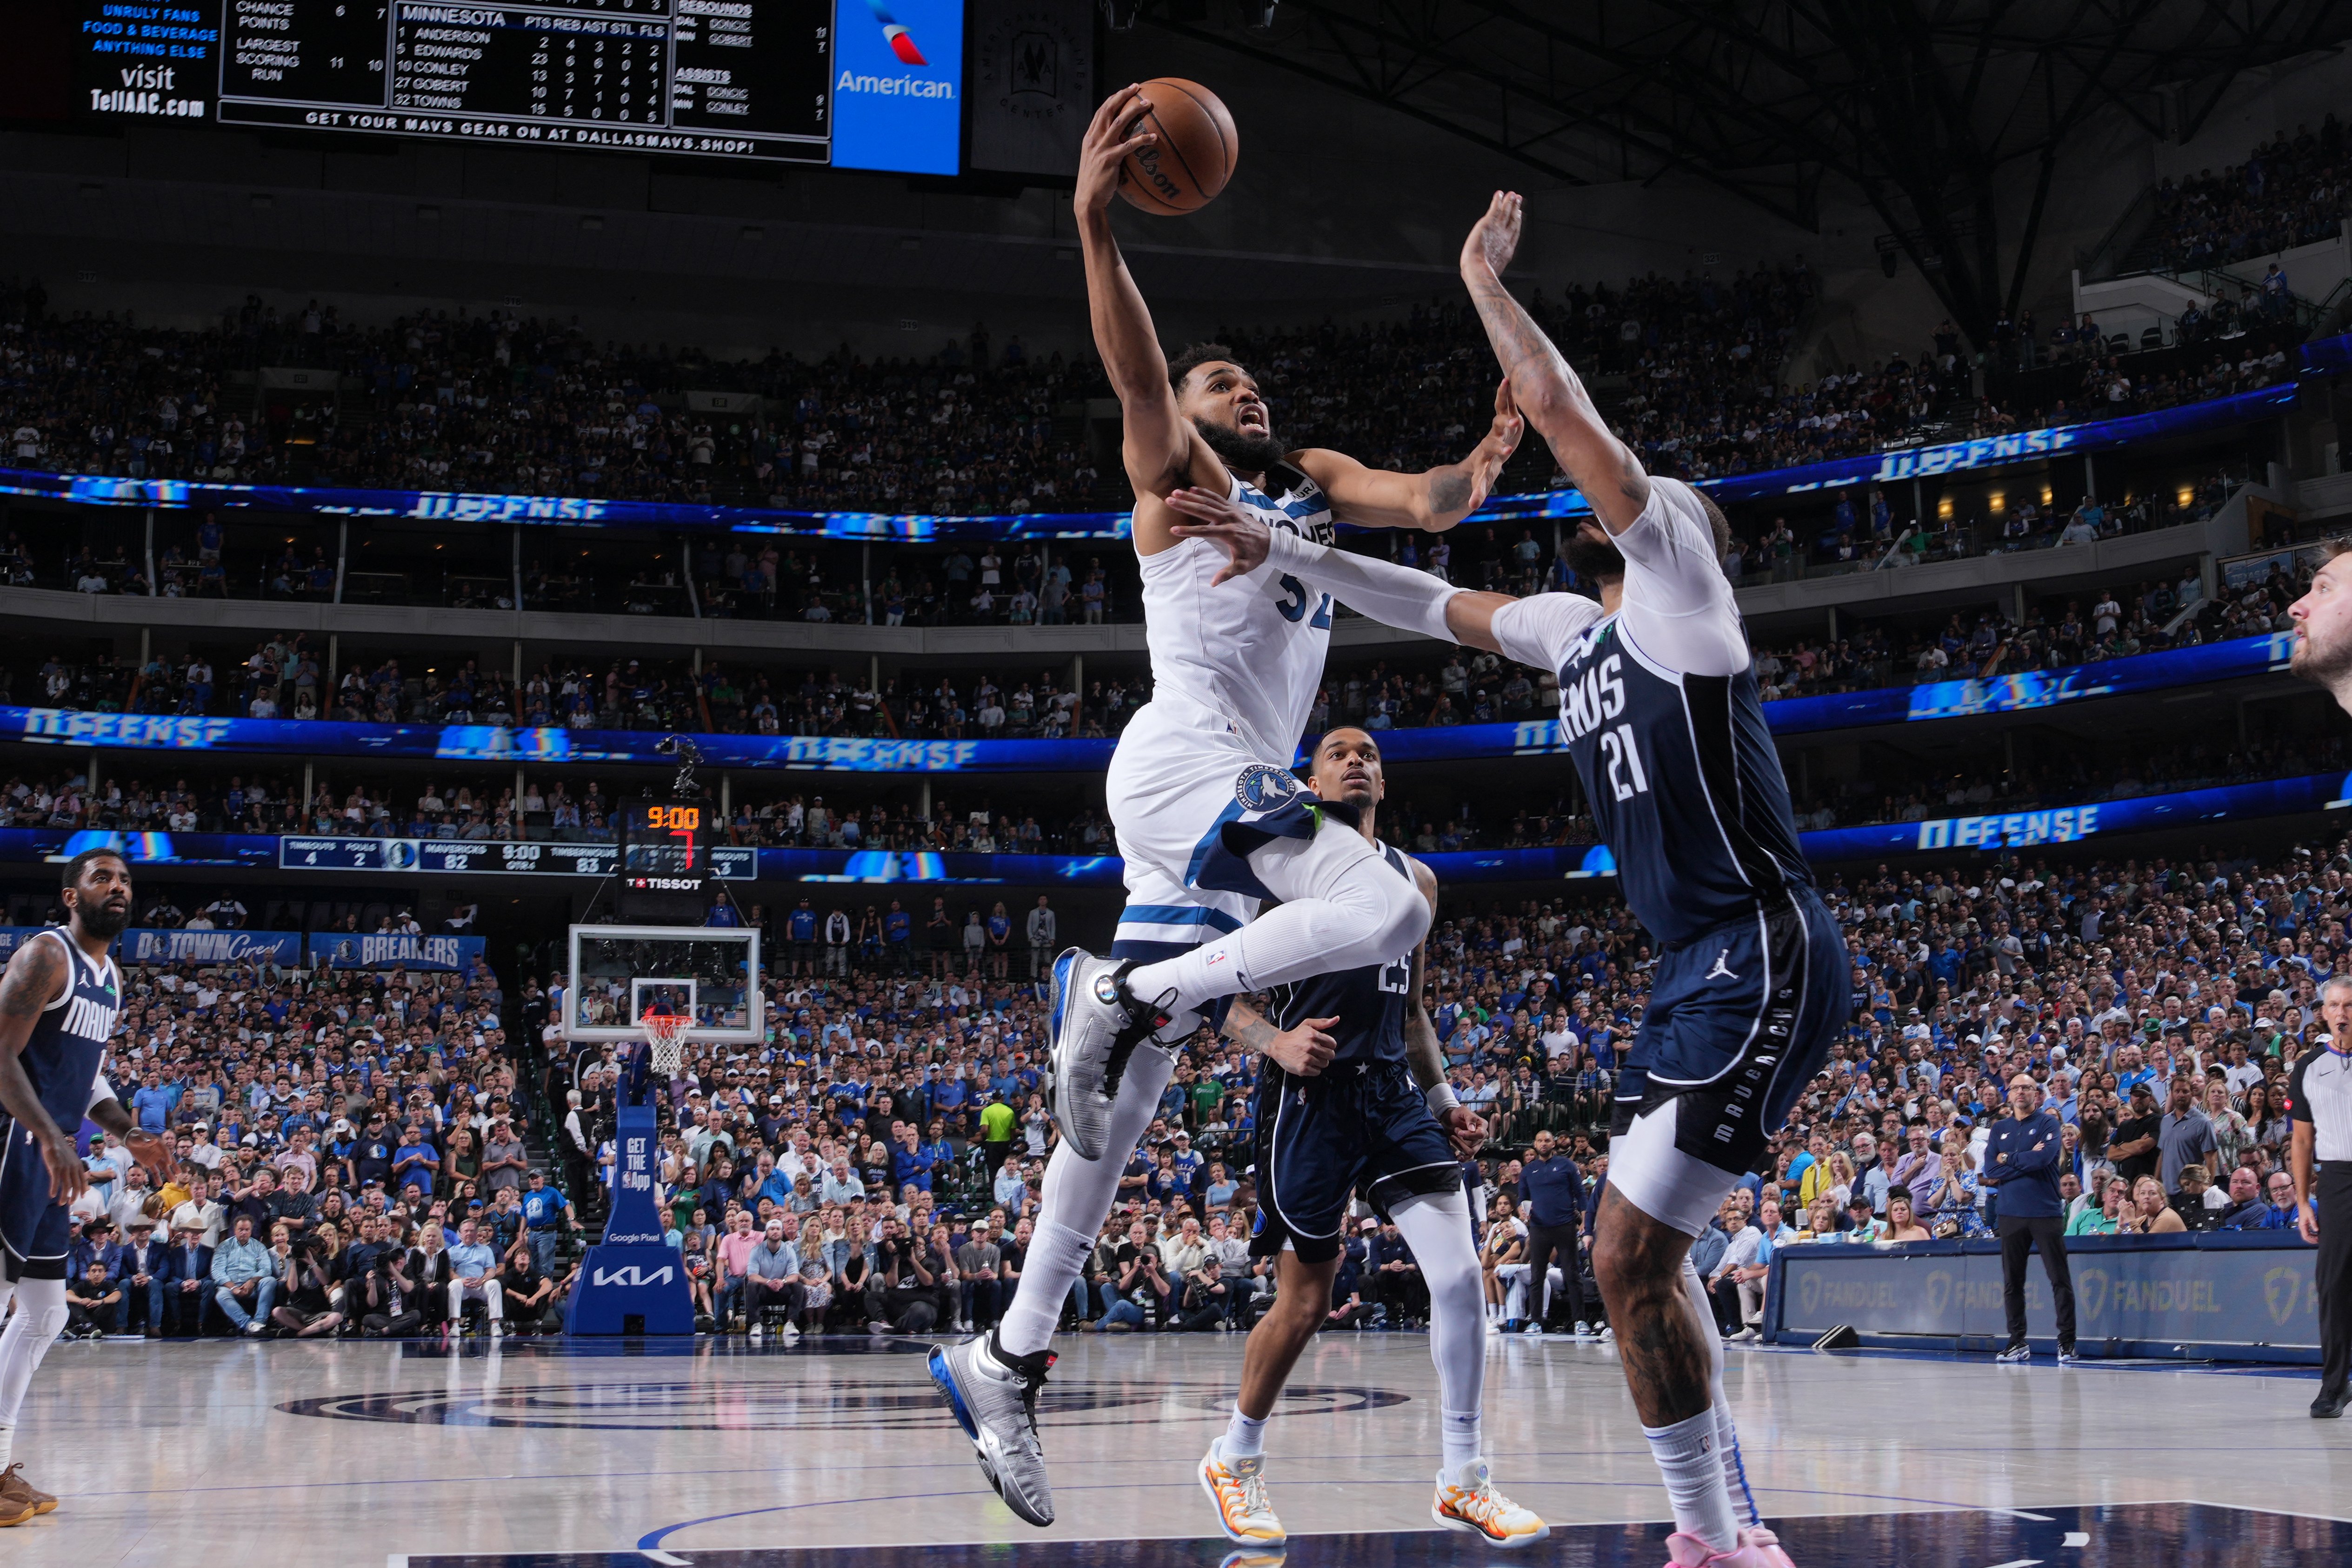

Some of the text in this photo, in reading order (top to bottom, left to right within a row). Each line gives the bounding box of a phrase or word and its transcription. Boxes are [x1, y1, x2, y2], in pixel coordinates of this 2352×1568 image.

[103, 4, 200, 22] UNRULY FANS
[236, 0, 294, 16] CHANCE
[335, 5, 346, 17] 6
[377, 8, 386, 20] 7
[678, 0, 753, 16] REBOUNDS
[239, 15, 290, 30] POINTS
[402, 5, 665, 37] MINNESOTA PTS REB AST STL FLS
[675, 16, 699, 27] DAL
[83, 21, 218, 41] FOOD & BEVERAGE
[675, 31, 696, 42] MIN
[708, 33, 753, 46] GOBERT
[93, 40, 207, 58] ANYTHING ELSE
[236, 37, 301, 53] LARGEST
[398, 27, 659, 56] 1 ANDERSON 2 4 3 2 2
[236, 52, 300, 67] SCORING
[330, 56, 344, 68] 11
[367, 59, 384, 71] 10
[396, 43, 658, 73] 5 EDWARDS 23 6 6 0 4
[252, 68, 282, 81] RUN
[396, 60, 658, 89] 10 CONLEY 13 3 7 4 1
[675, 67, 731, 82] ASSISTS
[394, 76, 657, 106] 27 GOBERT 10 7 1 0 4
[673, 84, 696, 95] DAL
[836, 69, 953, 99] American
[91, 88, 205, 117] TellAAC.com
[394, 93, 657, 122] 32 TOWNS 15 5 0 0 5
[673, 99, 693, 109] MIN
[1000, 98, 1065, 119] CENTER
[306, 112, 754, 153] GET YOUR MAVS GEAR ON AT DALLASMAVS.SHOP!
[505, 297, 521, 306] 318
[901, 321, 917, 329] 319
[1600, 723, 1648, 802] 21
[648, 807, 700, 830] 9:00
[1917, 806, 2099, 850] DEFENSE
[425, 844, 487, 855] MAVERICKS
[669, 830, 693, 870] 7
[305, 851, 317, 865] 4
[354, 853, 366, 866] 2
[445, 854, 468, 870] 82
[576, 857, 600, 873] 83
[721, 861, 732, 875] 3
[647, 878, 701, 890] TISSOT
[169, 933, 232, 960] TOWN
[627, 1137, 646, 1154] GET
[626, 1154, 646, 1170] THE
[1176, 1163, 1194, 1172] ALLAS
[631, 1171, 650, 1191] App
[609, 1233, 660, 1244] Google Pixel
[1824, 1281, 1896, 1308] FANDUEL
[1955, 1281, 2044, 1310] FANDEL
[2113, 1280, 2222, 1314] FANDUEL
